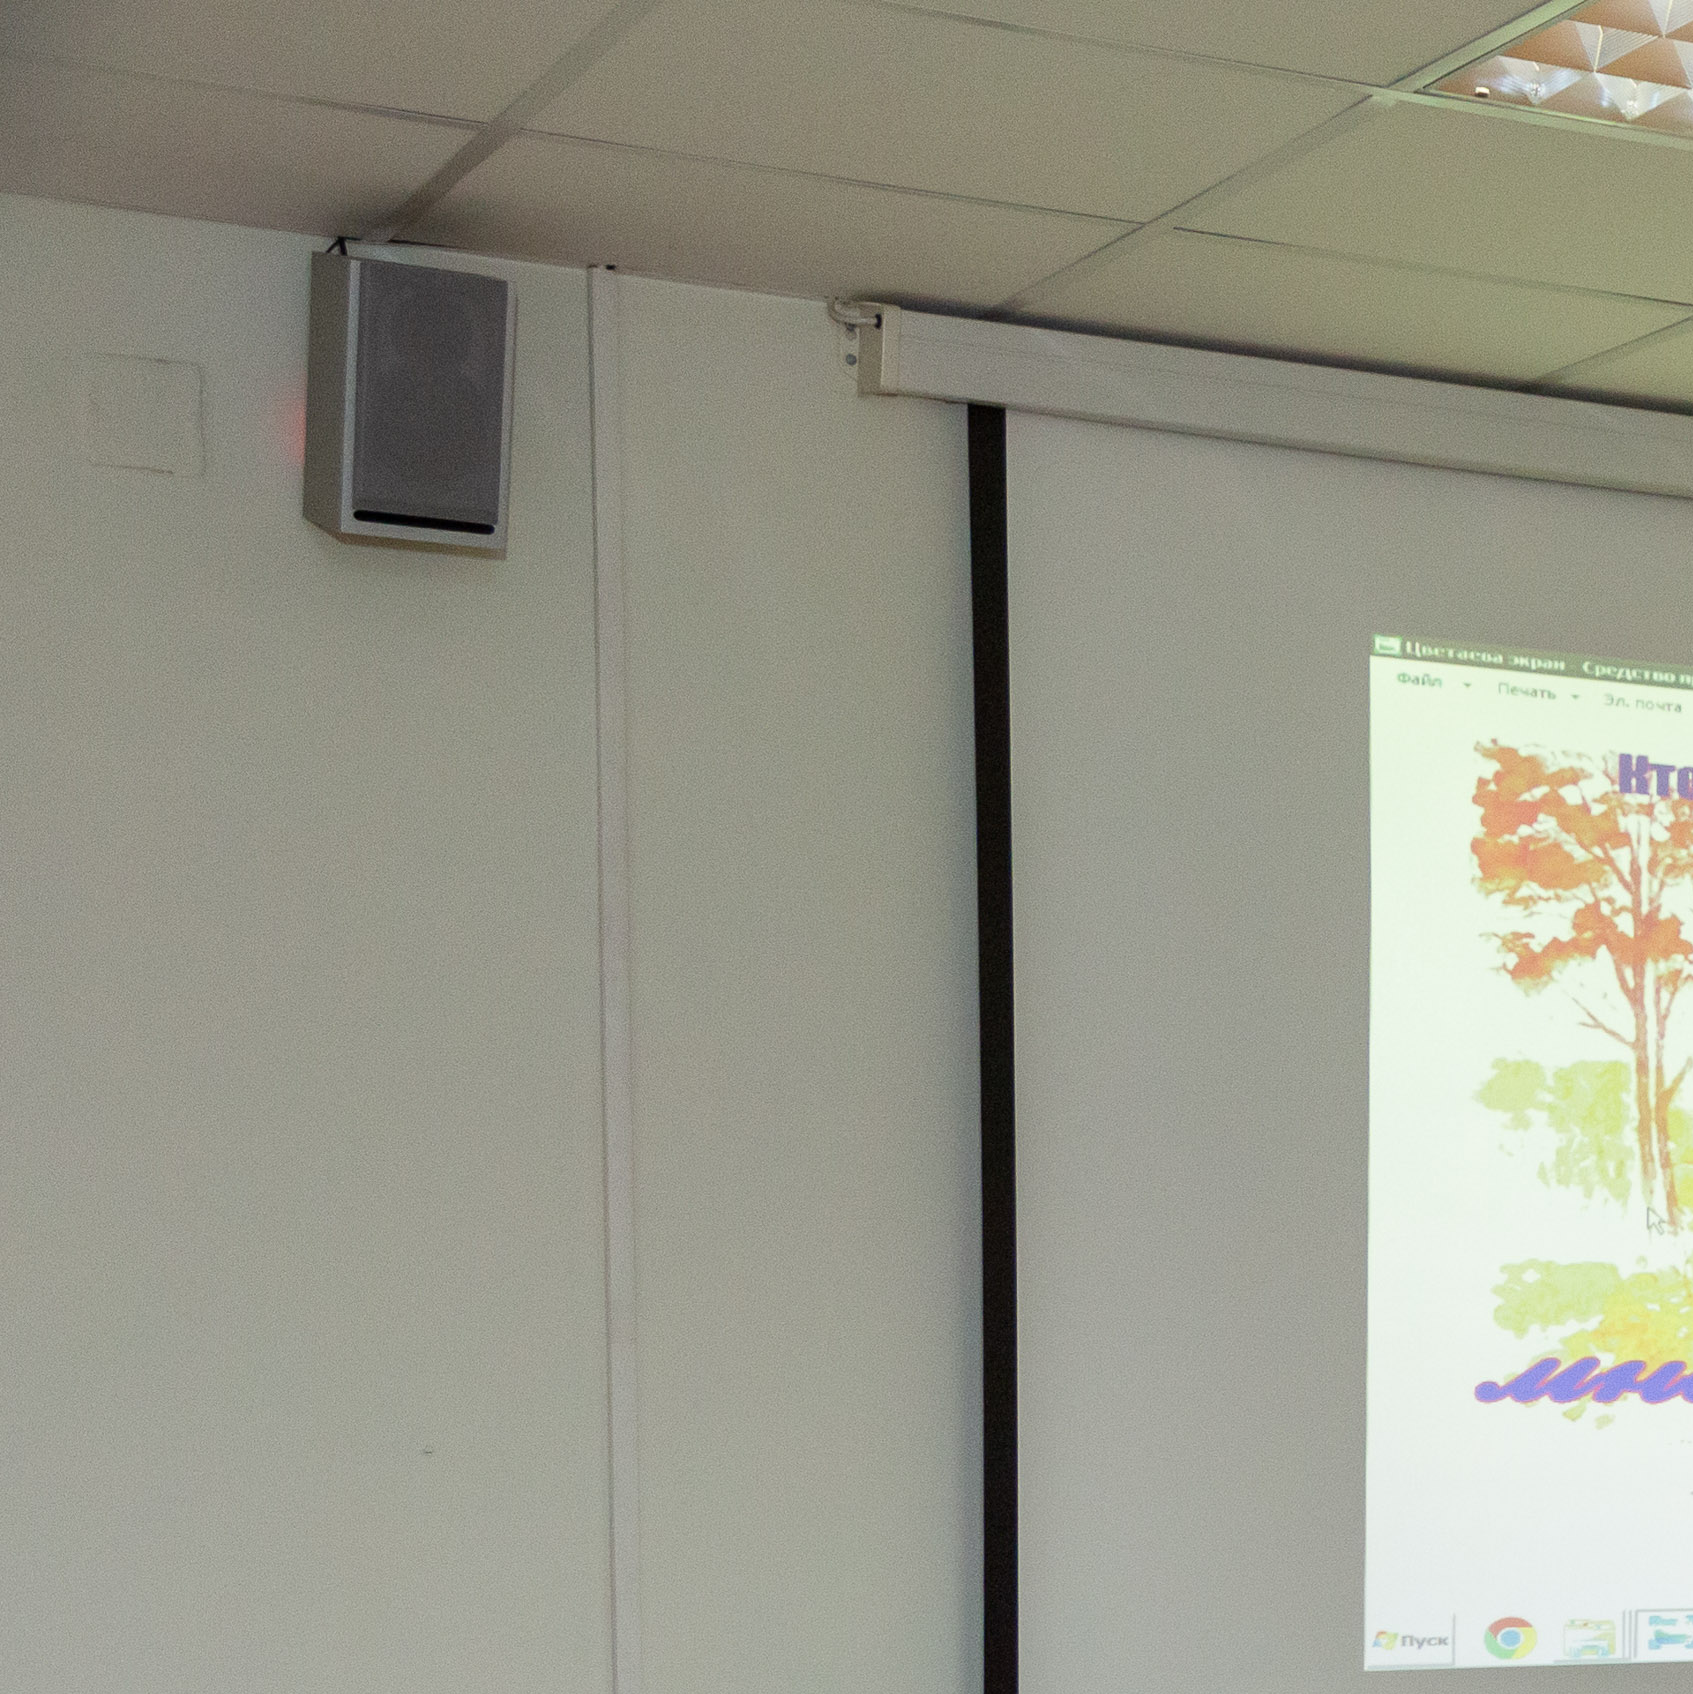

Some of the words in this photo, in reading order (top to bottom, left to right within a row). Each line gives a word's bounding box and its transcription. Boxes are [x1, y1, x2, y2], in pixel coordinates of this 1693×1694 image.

[1508, 654, 1566, 671] экран
[1582, 660, 1677, 684] Средство
[1397, 672, 1443, 688] Файл
[1498, 681, 1557, 700] Печать
[1635, 698, 1683, 713] почта
[1400, 1634, 1449, 1650] Пуск
